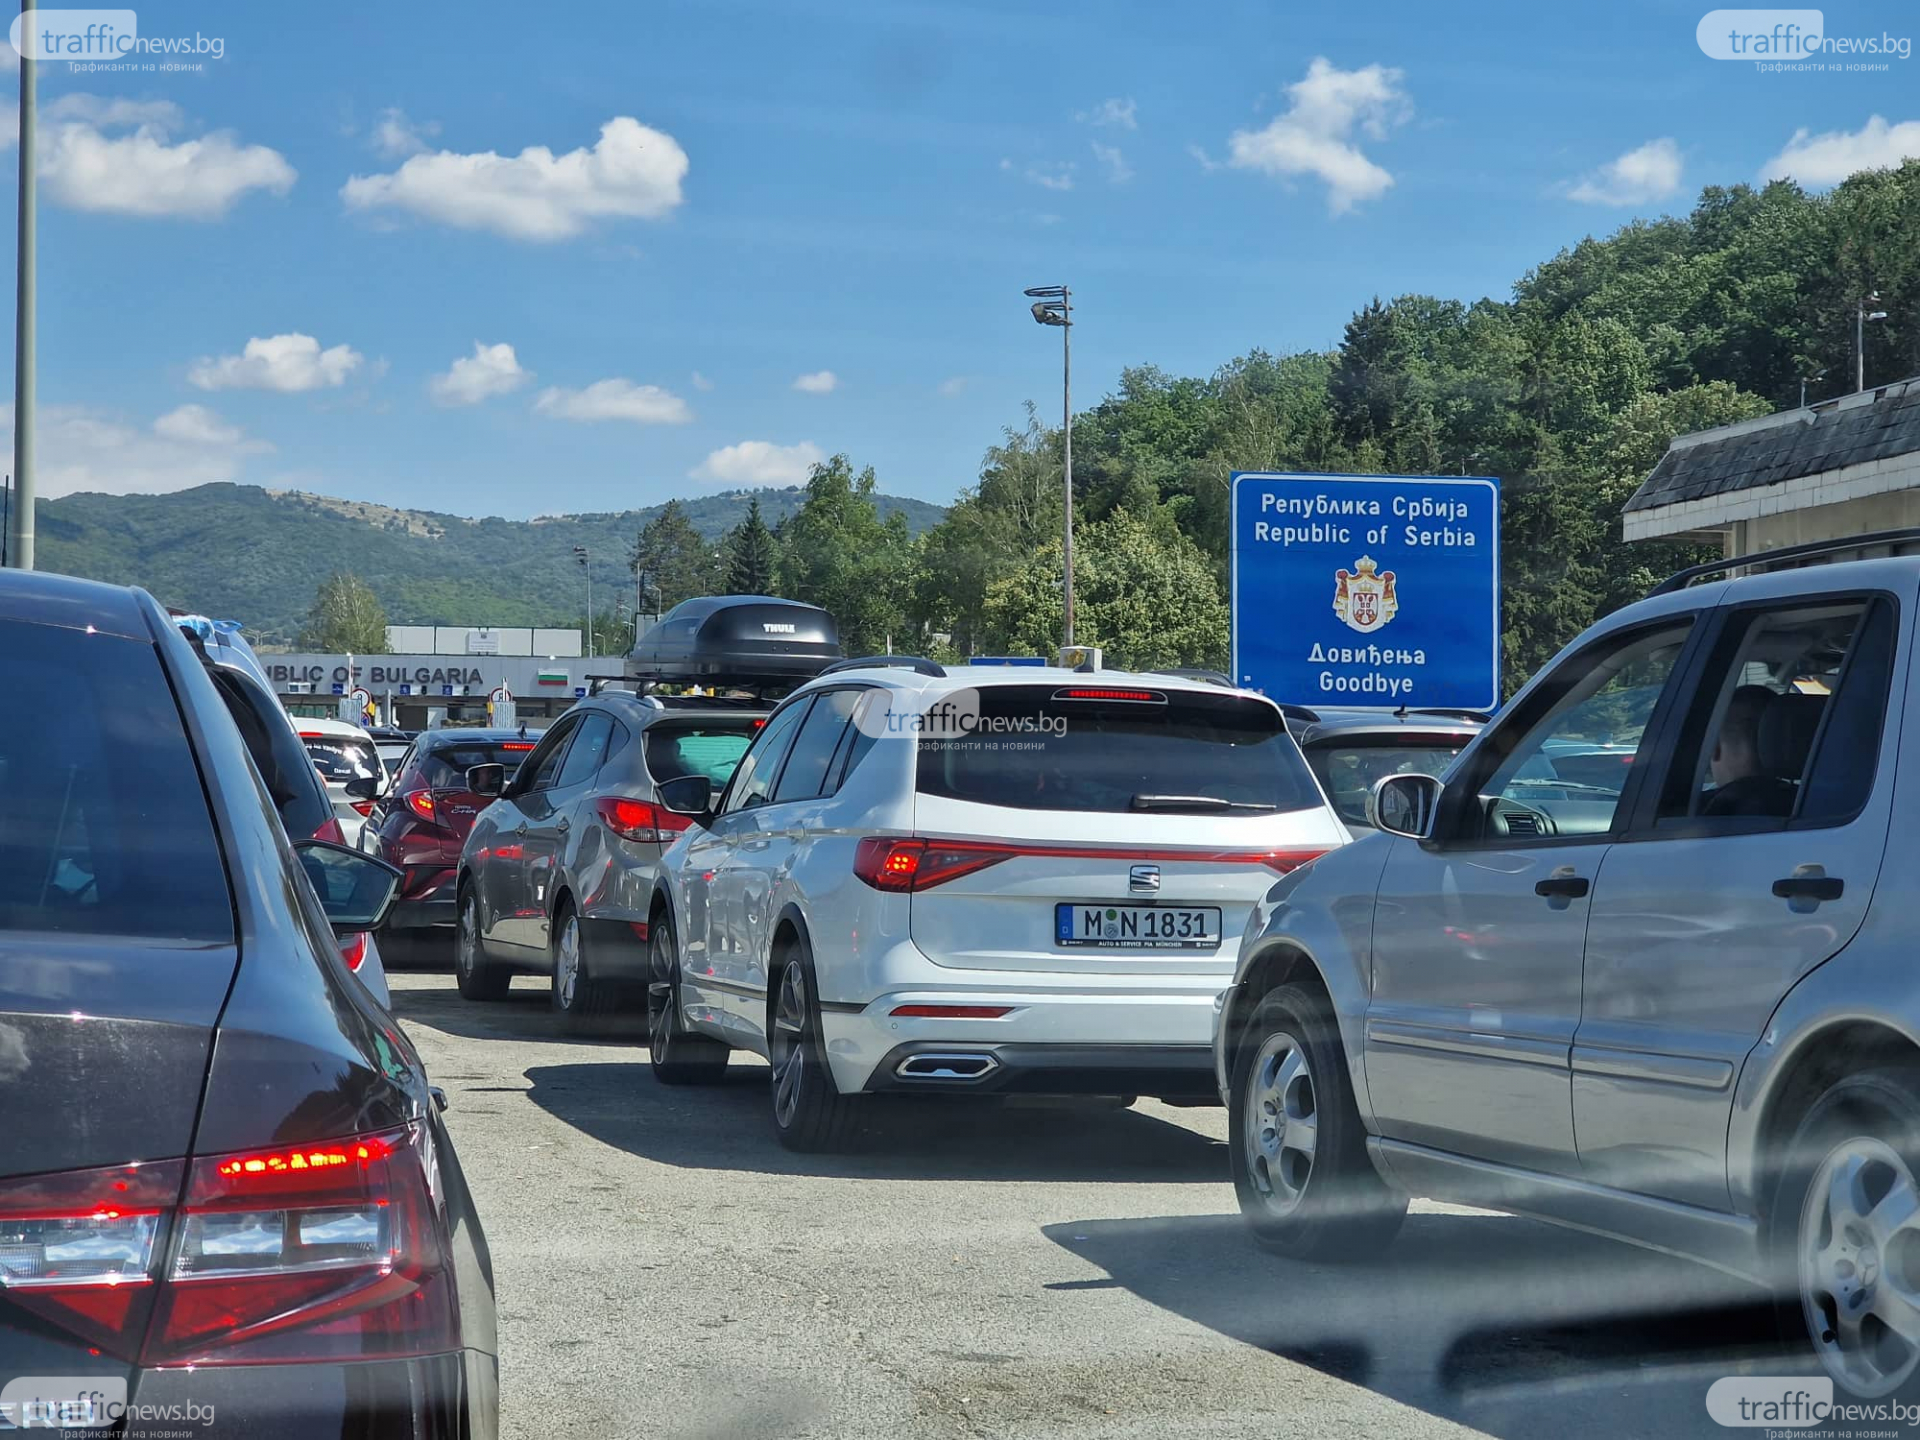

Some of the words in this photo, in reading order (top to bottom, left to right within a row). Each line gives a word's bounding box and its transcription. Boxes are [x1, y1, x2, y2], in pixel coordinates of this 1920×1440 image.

[1261, 493, 1381, 519] Република
[1392, 496, 1468, 522] Србија
[1255, 521, 1351, 547] Republic
[1366, 525, 1389, 545] of
[1404, 526, 1476, 547] Serbia
[763, 623, 795, 633] THULE
[1307, 643, 1426, 667] Довиђења
[332, 666, 362, 683] OF
[370, 666, 484, 684] BULGARIA
[1319, 671, 1414, 697] Goodbye
